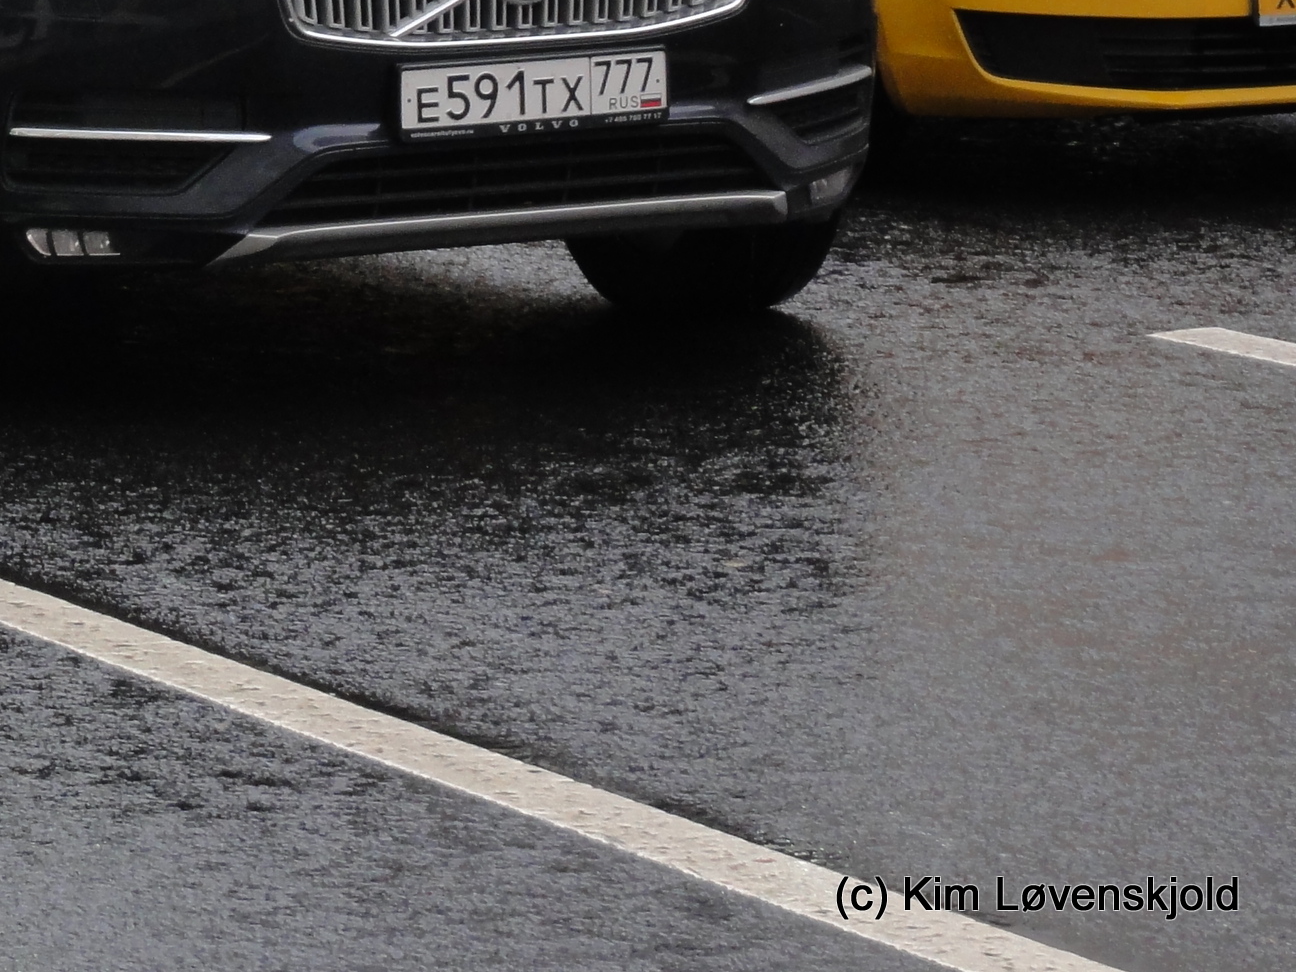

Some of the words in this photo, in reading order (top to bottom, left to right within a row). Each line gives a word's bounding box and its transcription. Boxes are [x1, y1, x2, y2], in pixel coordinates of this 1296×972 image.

[593, 56, 653, 96] 777
[609, 95, 639, 110] RUS
[500, 118, 579, 133] VOLVO
